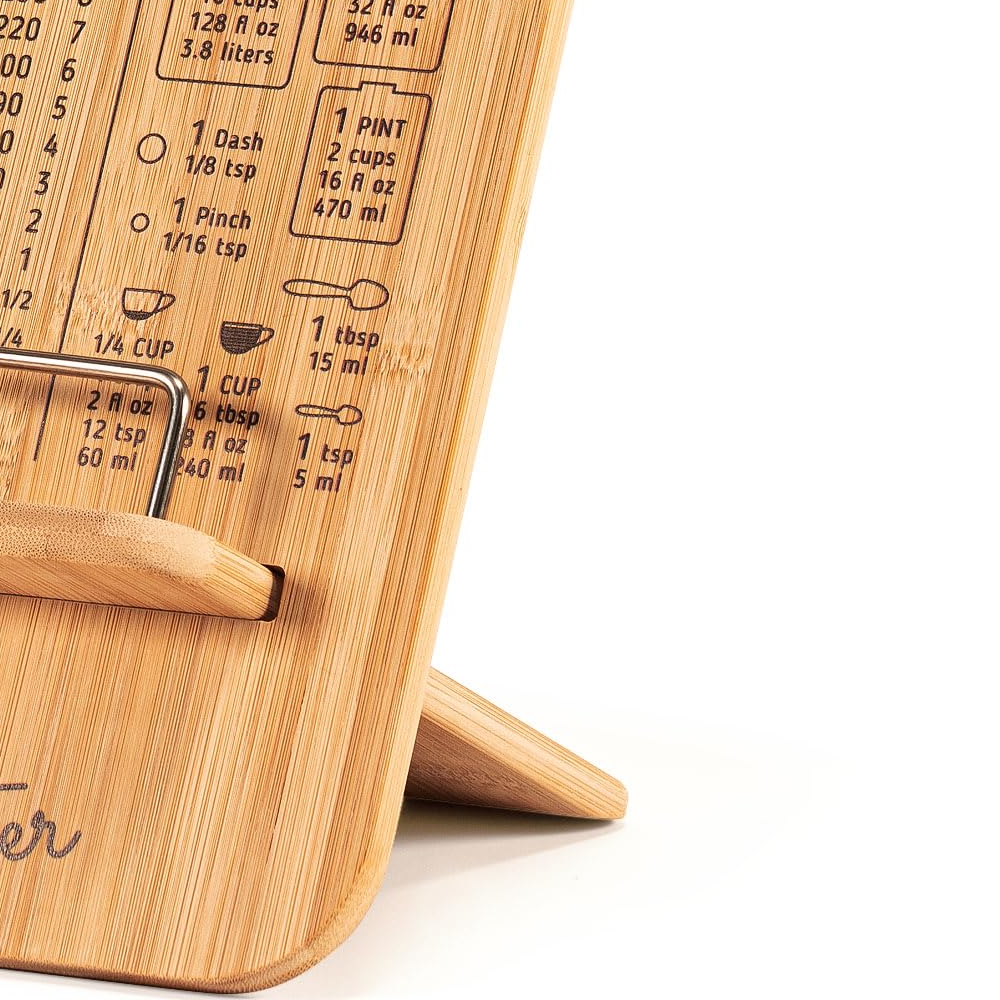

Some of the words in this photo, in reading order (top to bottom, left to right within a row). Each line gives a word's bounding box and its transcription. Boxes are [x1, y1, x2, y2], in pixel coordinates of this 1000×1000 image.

[403, 3, 428, 20] oz
[191, 11, 228, 34] 128
[256, 21, 280, 38] oz
[344, 22, 383, 45] 946
[391, 27, 418, 47] ml
[180, 38, 213, 61] 3.8
[220, 41, 274, 66] liters
[214, 128, 264, 152] Dash
[356, 116, 408, 139] PINT
[186, 154, 217, 176] 1/8
[225, 159, 257, 184] tsp
[348, 148, 396, 170] cups
[319, 169, 342, 191] 16
[372, 178, 396, 196] oz
[195, 206, 252, 230] Pinch
[312, 197, 352, 220] 470
[360, 203, 387, 223] ml
[164, 232, 207, 255] 1/16
[215, 237, 248, 263] tsp
[95, 333, 124, 356] 1/4
[133, 337, 174, 360] CUP
[335, 325, 380, 353] tbsp
[310, 351, 334, 372] 15
[341, 355, 369, 376] ml
[219, 374, 261, 397] CUP
[129, 399, 154, 416] oz
[215, 403, 261, 430] tbsp
[84, 418, 107, 440] 12
[114, 423, 147, 448] tsp
[224, 437, 248, 454] oz
[77, 446, 103, 468] 60
[111, 452, 137, 471] ml
[321, 443, 354, 470] tsp
[218, 463, 245, 482] ml
[315, 472, 343, 493] ml
